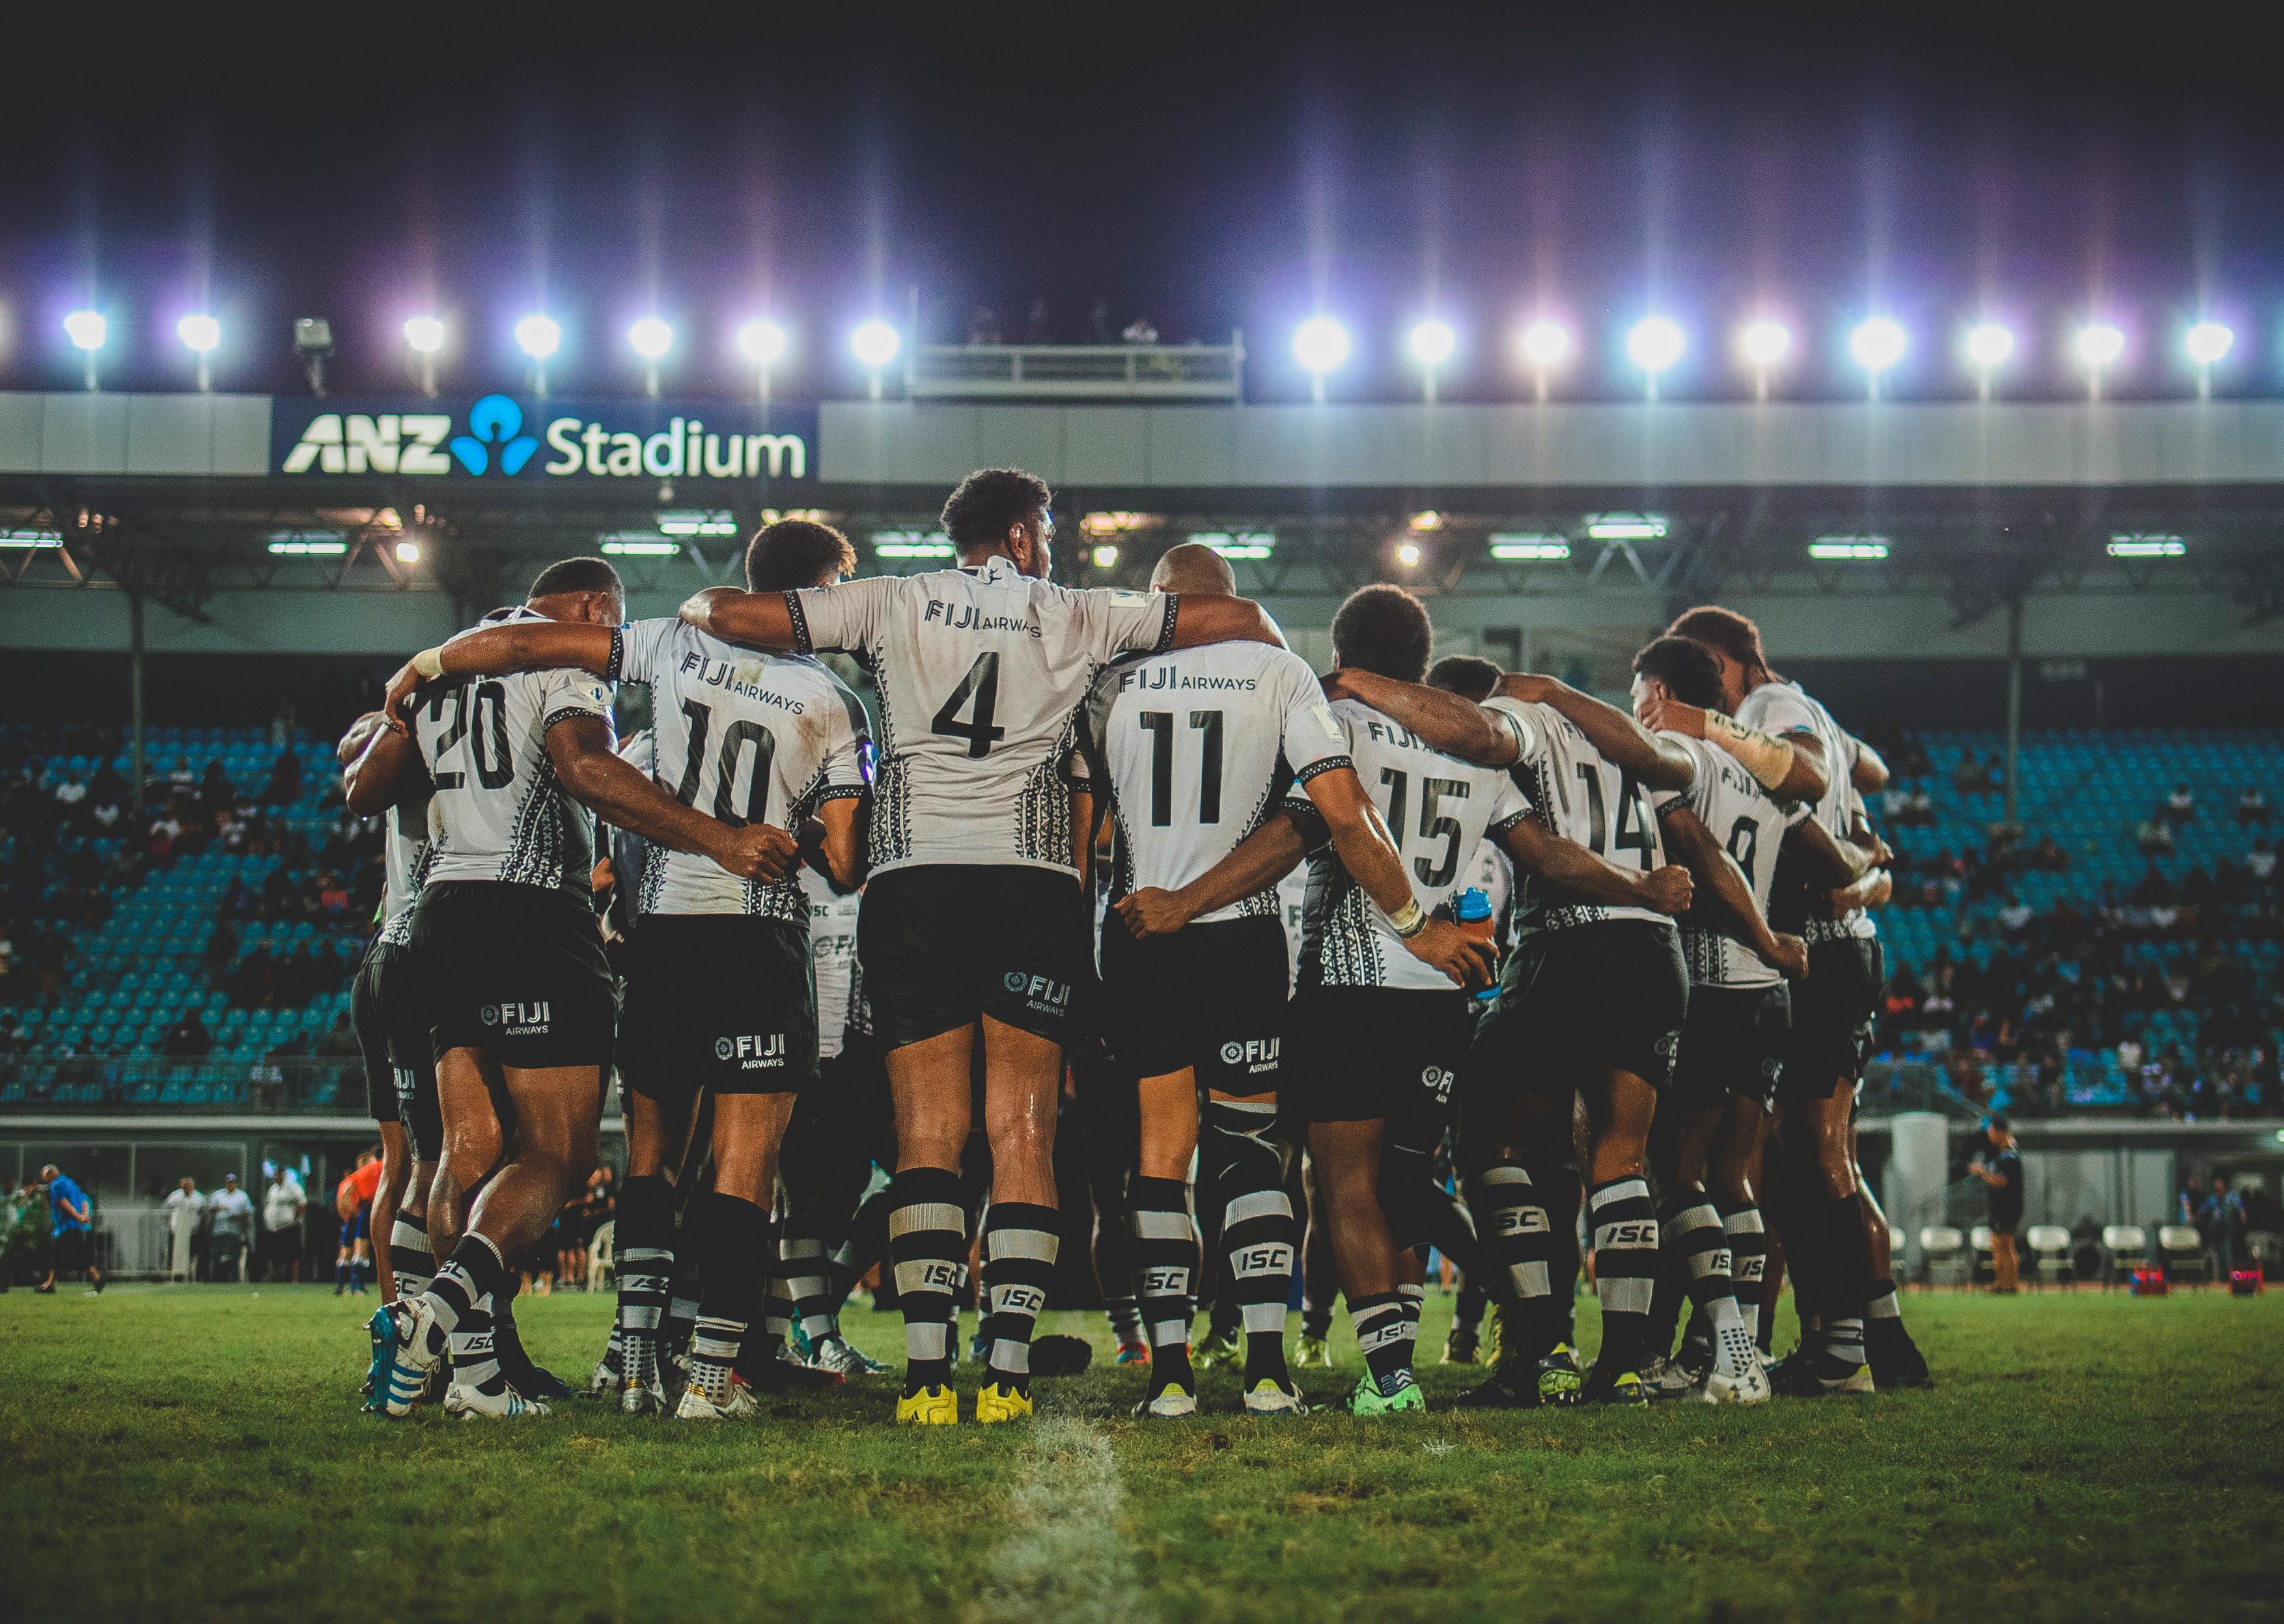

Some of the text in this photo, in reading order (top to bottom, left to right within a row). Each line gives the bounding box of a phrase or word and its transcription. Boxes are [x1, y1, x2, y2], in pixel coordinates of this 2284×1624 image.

[283, 414, 807, 478] ANZ Stadium
[925, 599, 980, 631] FIJI
[680, 651, 804, 715] FIJI AIRWAYS
[1119, 665, 1257, 693] FIJI AIRWAYS
[931, 652, 1005, 759] 4
[430, 681, 514, 790] 20
[676, 696, 775, 829] 10
[1139, 710, 1223, 827] 11
[1380, 767, 1470, 887] 15
[1576, 762, 1658, 871] 14
[1027, 975, 1071, 1006] FIJI
[501, 1001, 550, 1025] FIJI
[1026, 999, 1065, 1017] AIRWAYS
[505, 1025, 549, 1036] AIRWAYS
[736, 1034, 785, 1058] FIJI
[1246, 1037, 1281, 1063] FIJI
[742, 1058, 785, 1069] AIRWAYS
[1249, 1060, 1279, 1073] AIRWAYS
[1497, 1211, 1539, 1230] SC
[1607, 1226, 1655, 1243] ISC
[1242, 1249, 1288, 1271] ISC
[1711, 1254, 1730, 1269] IS
[1742, 1259, 1764, 1275] IS
[1001, 1289, 1042, 1311] ISC
